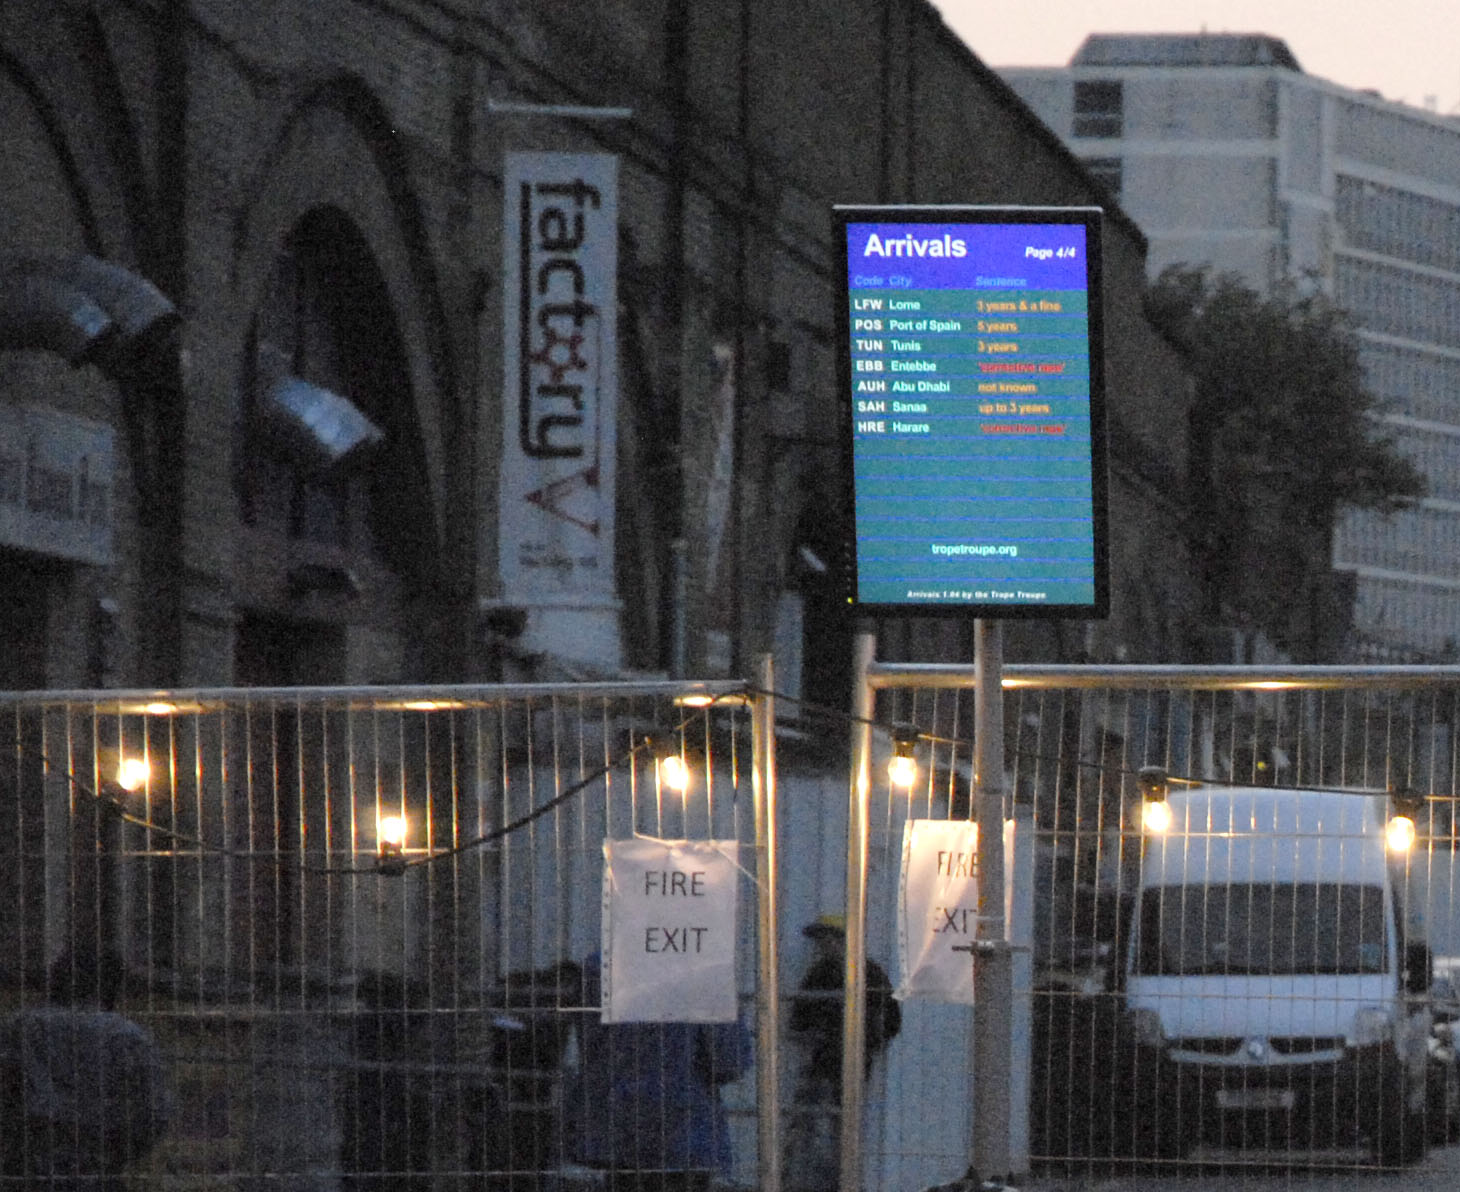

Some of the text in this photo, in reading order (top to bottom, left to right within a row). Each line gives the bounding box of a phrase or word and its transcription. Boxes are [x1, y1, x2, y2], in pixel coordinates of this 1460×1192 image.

[864, 234, 967, 257] Arrivals
[1025, 247, 1053, 260] Page
[854, 299, 883, 310] LFW
[889, 299, 920, 310] Lome
[855, 319, 882, 330] POS
[890, 319, 913, 330] Port
[915, 319, 927, 330] of
[929, 319, 961, 333] Spain
[986, 323, 1018, 333] years
[856, 340, 883, 351] TUN
[891, 340, 921, 351] Tunis
[988, 343, 1018, 354] years
[856, 361, 883, 371] EBB
[891, 361, 937, 371] Entebbe
[857, 381, 1038, 393] AUH Abu Dhabi not known
[858, 401, 885, 412] SAH
[893, 401, 927, 412] Sanaa
[979, 404, 993, 415] up
[996, 402, 1007, 413] to
[1019, 404, 1051, 415] years
[858, 422, 885, 432] HRE
[893, 422, 930, 433] Harare
[932, 544, 1017, 557] tropetroupe.org
[938, 851, 979, 878] FIRE
[645, 871, 705, 896] FIRE
[645, 927, 708, 953] EXIT
